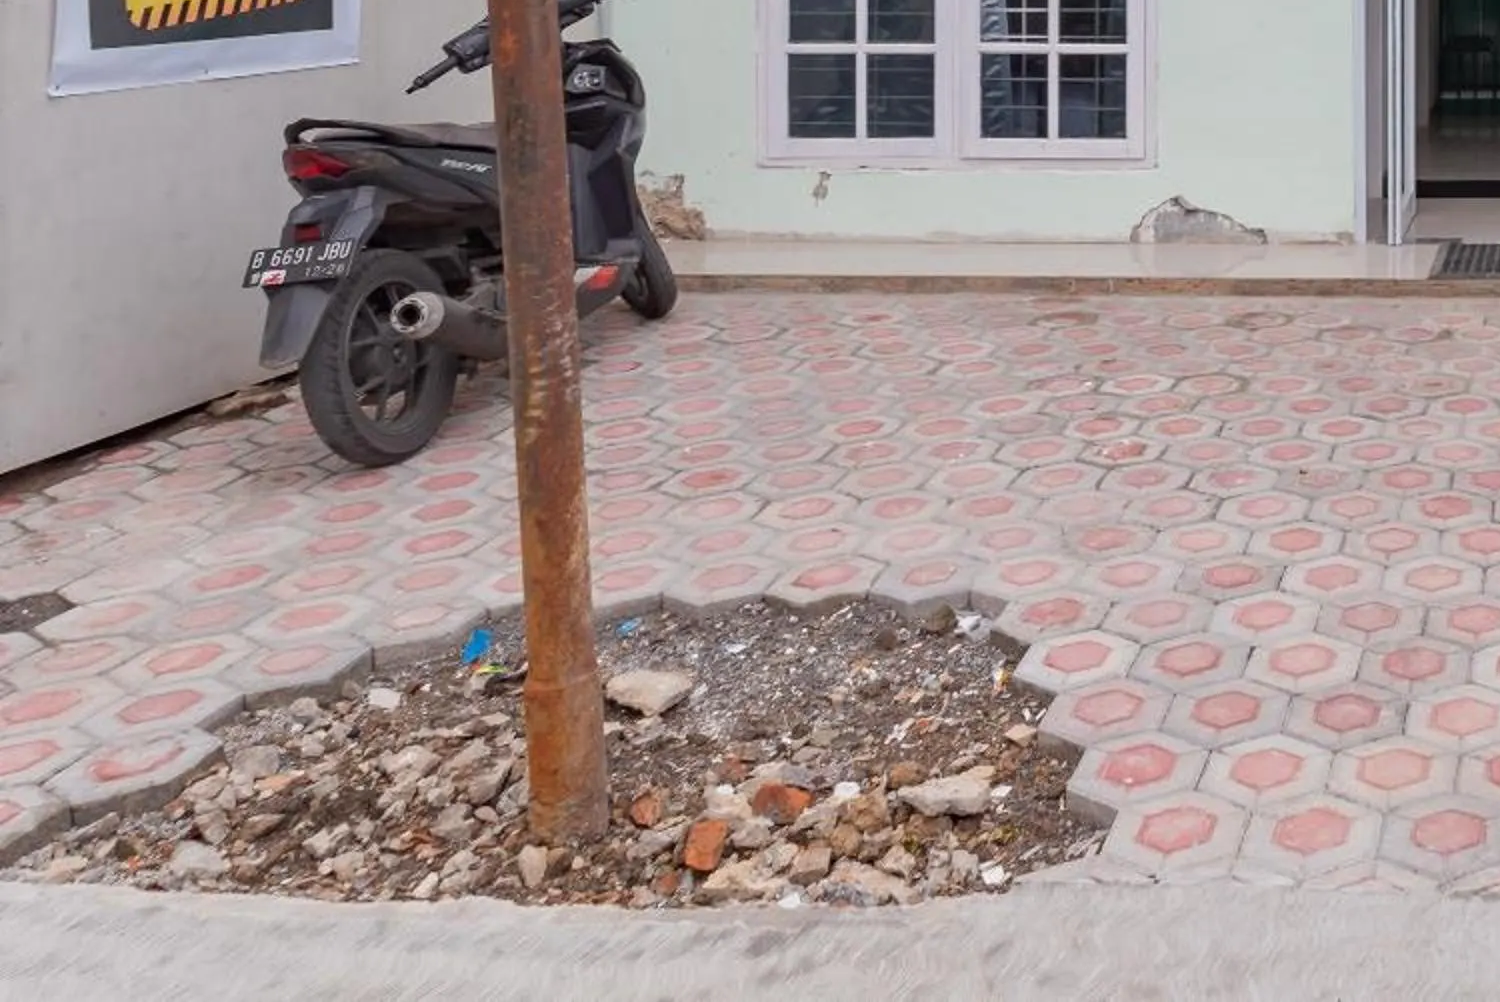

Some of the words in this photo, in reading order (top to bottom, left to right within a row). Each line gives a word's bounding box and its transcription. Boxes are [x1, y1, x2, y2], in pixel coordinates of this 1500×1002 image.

[252, 251, 265, 269] B
[271, 245, 314, 267] 6691
[318, 241, 352, 261] JBU
